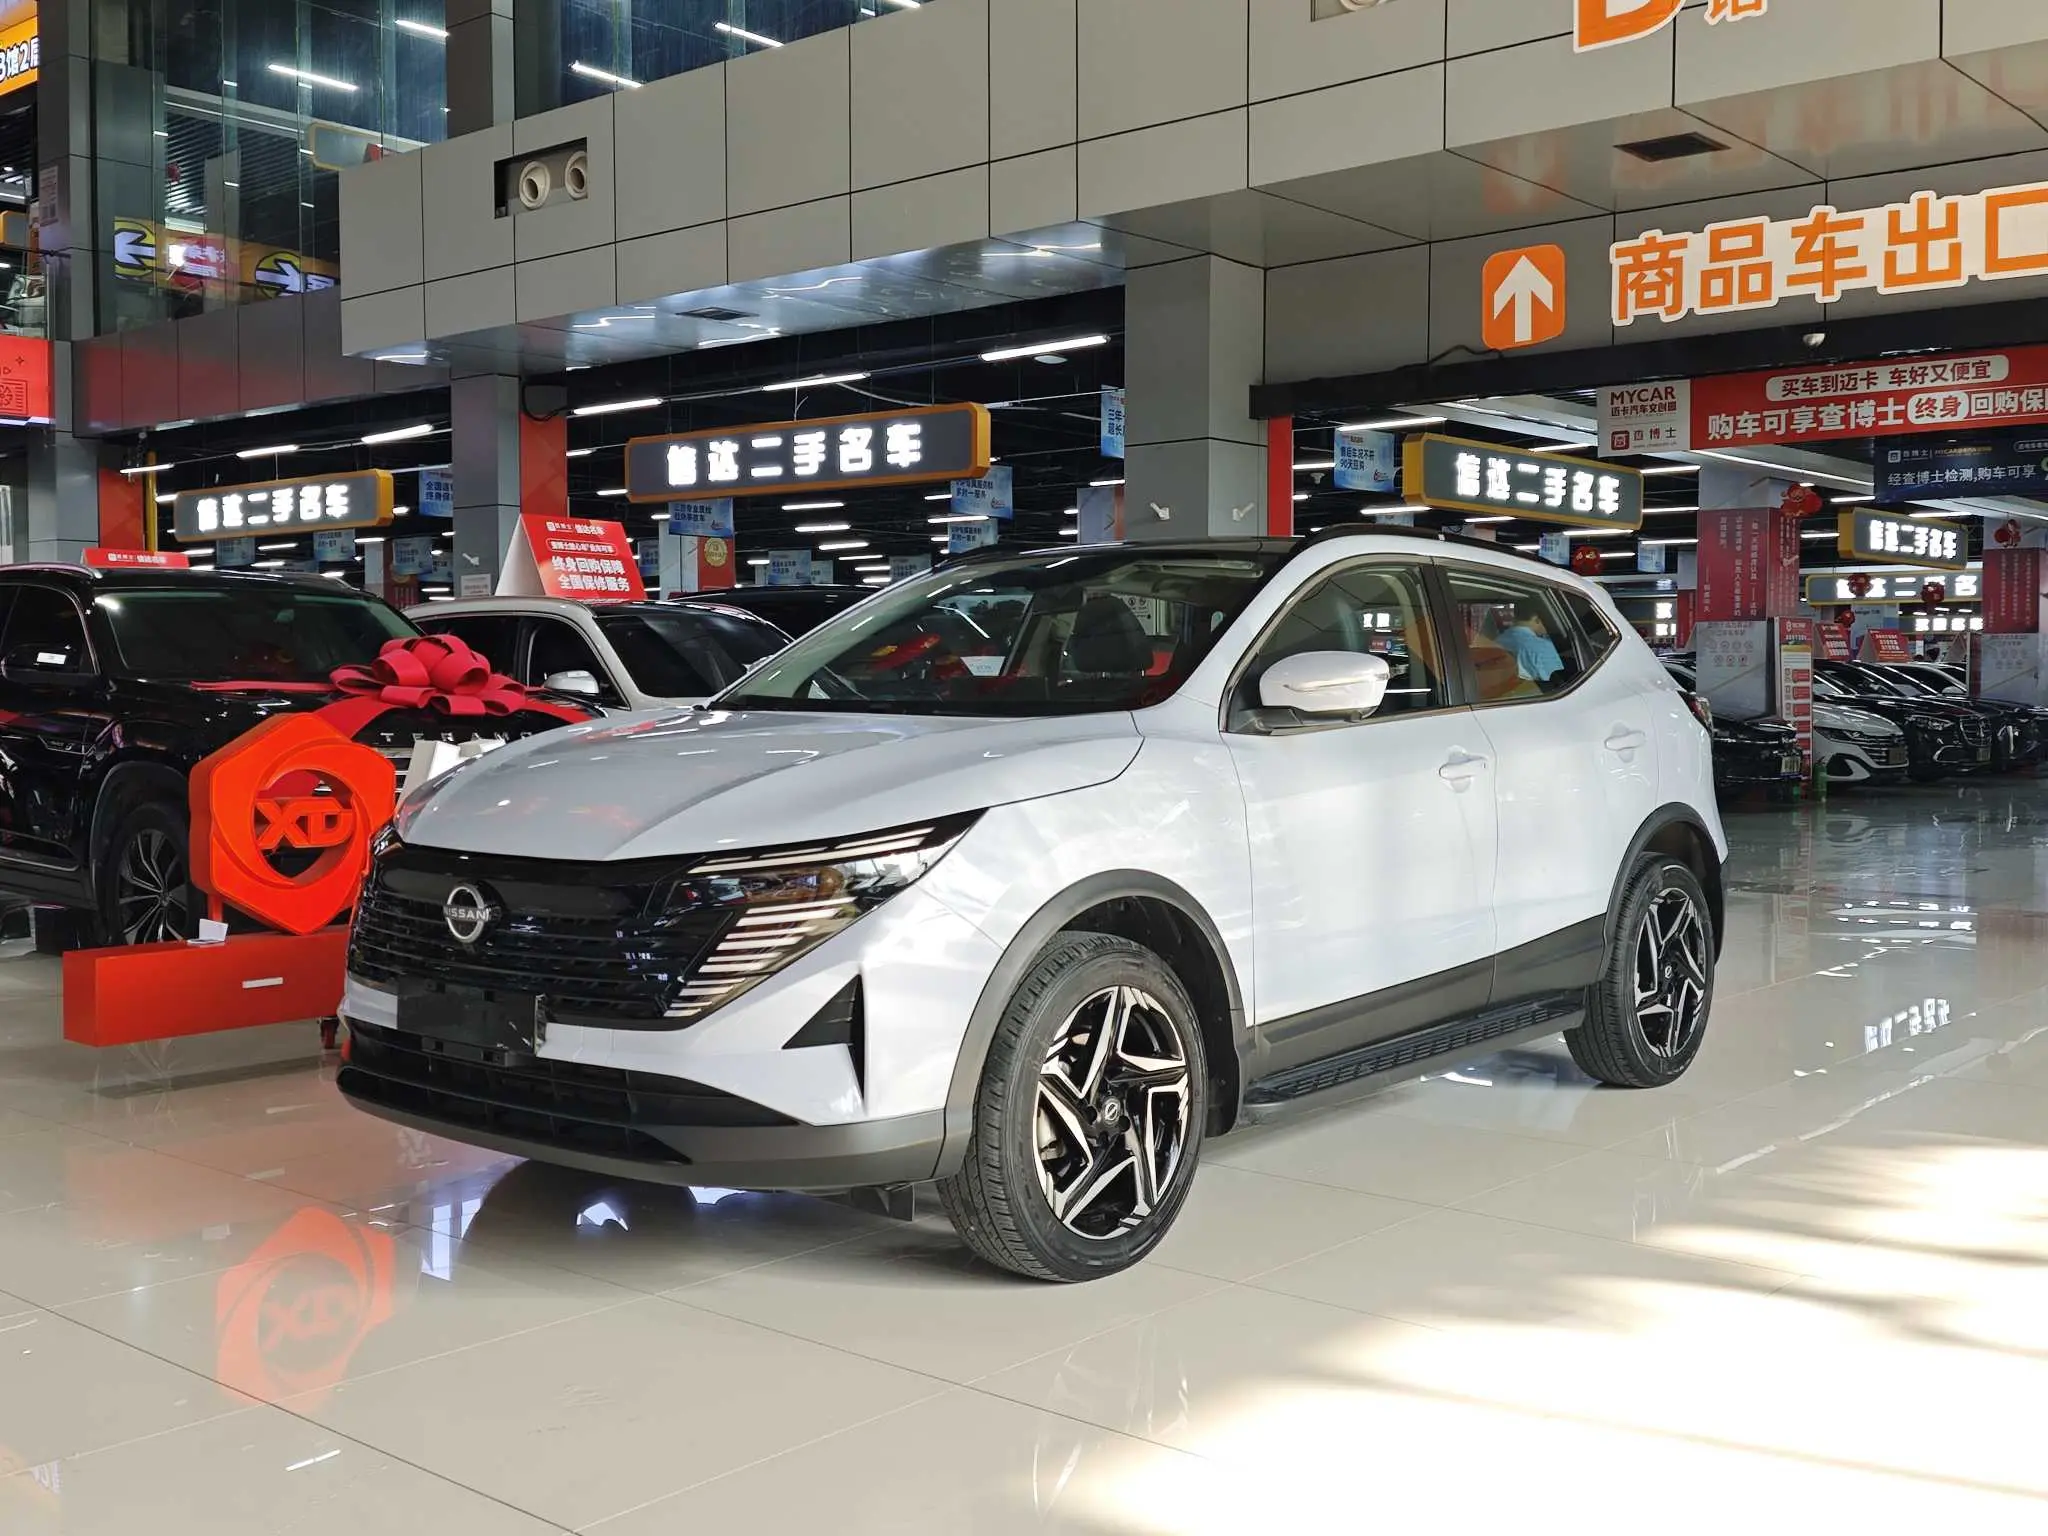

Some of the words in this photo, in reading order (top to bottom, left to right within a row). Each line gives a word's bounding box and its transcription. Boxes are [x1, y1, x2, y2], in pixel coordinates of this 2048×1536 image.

[1613, 186, 2048, 320] 商品车出口
[1610, 386, 1677, 406] MYCAR
[1782, 371, 1879, 397] 买车到迈卡
[1889, 360, 1991, 387] 车好又便宜
[1708, 387, 2048, 441] 购车可享查博士终身回购保
[667, 423, 922, 487] 信达二手名车
[1455, 452, 1620, 516] 信达二手名车
[197, 483, 349, 533] 信达二手名车
[1869, 519, 1957, 559] 信达二手名车
[551, 556, 626, 574] 终身回购保障
[558, 573, 630, 592] 全国保修服务
